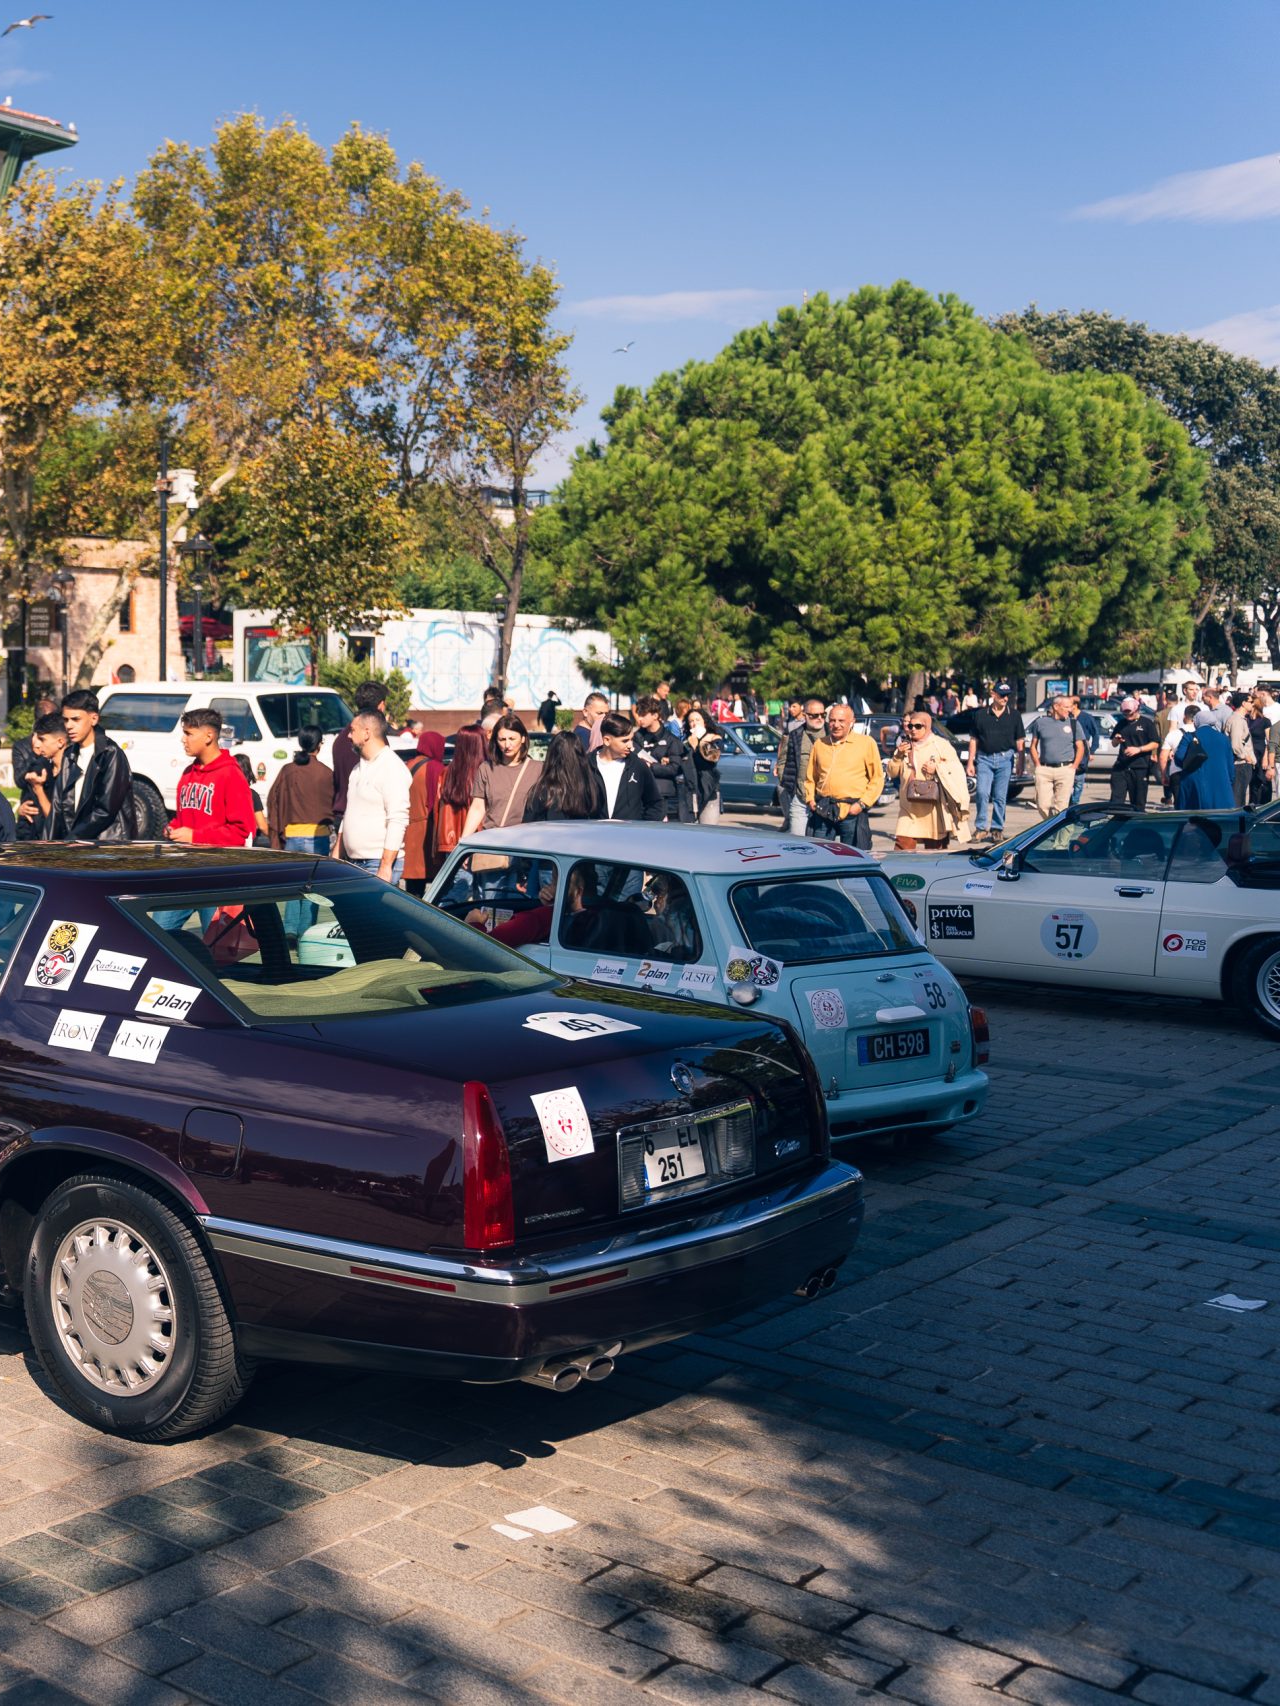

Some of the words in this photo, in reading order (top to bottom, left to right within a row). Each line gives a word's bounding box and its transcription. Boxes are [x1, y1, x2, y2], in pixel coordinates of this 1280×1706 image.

[896, 877, 918, 887] FIVA
[931, 905, 971, 921] privia
[1055, 924, 1084, 950] 57
[63, 950, 74, 962] AL
[638, 962, 670, 979] 2plan
[681, 971, 716, 984] GUSTO
[143, 984, 192, 1012] 2plan
[923, 982, 946, 1010] 58
[558, 1019, 608, 1033] 49
[115, 1032, 162, 1050] GUSTO
[873, 1035, 894, 1059] CH
[898, 1032, 925, 1056] 598
[677, 1125, 698, 1148] EL
[658, 1152, 685, 1183] 251
